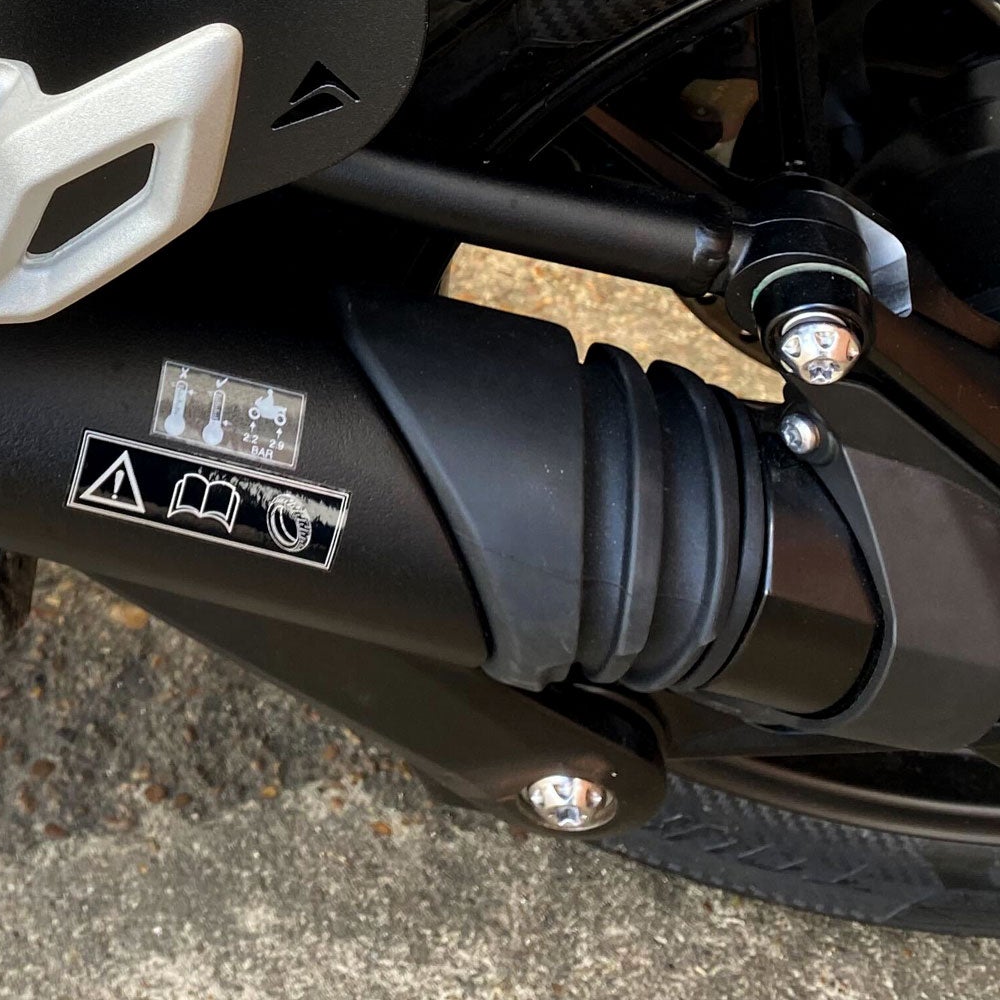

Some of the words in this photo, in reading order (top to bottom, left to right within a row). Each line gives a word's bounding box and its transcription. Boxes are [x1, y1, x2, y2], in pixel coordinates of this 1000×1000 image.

[242, 432, 259, 444] 2.2
[268, 438, 285, 451] 2.9
[251, 445, 274, 460] BAR
